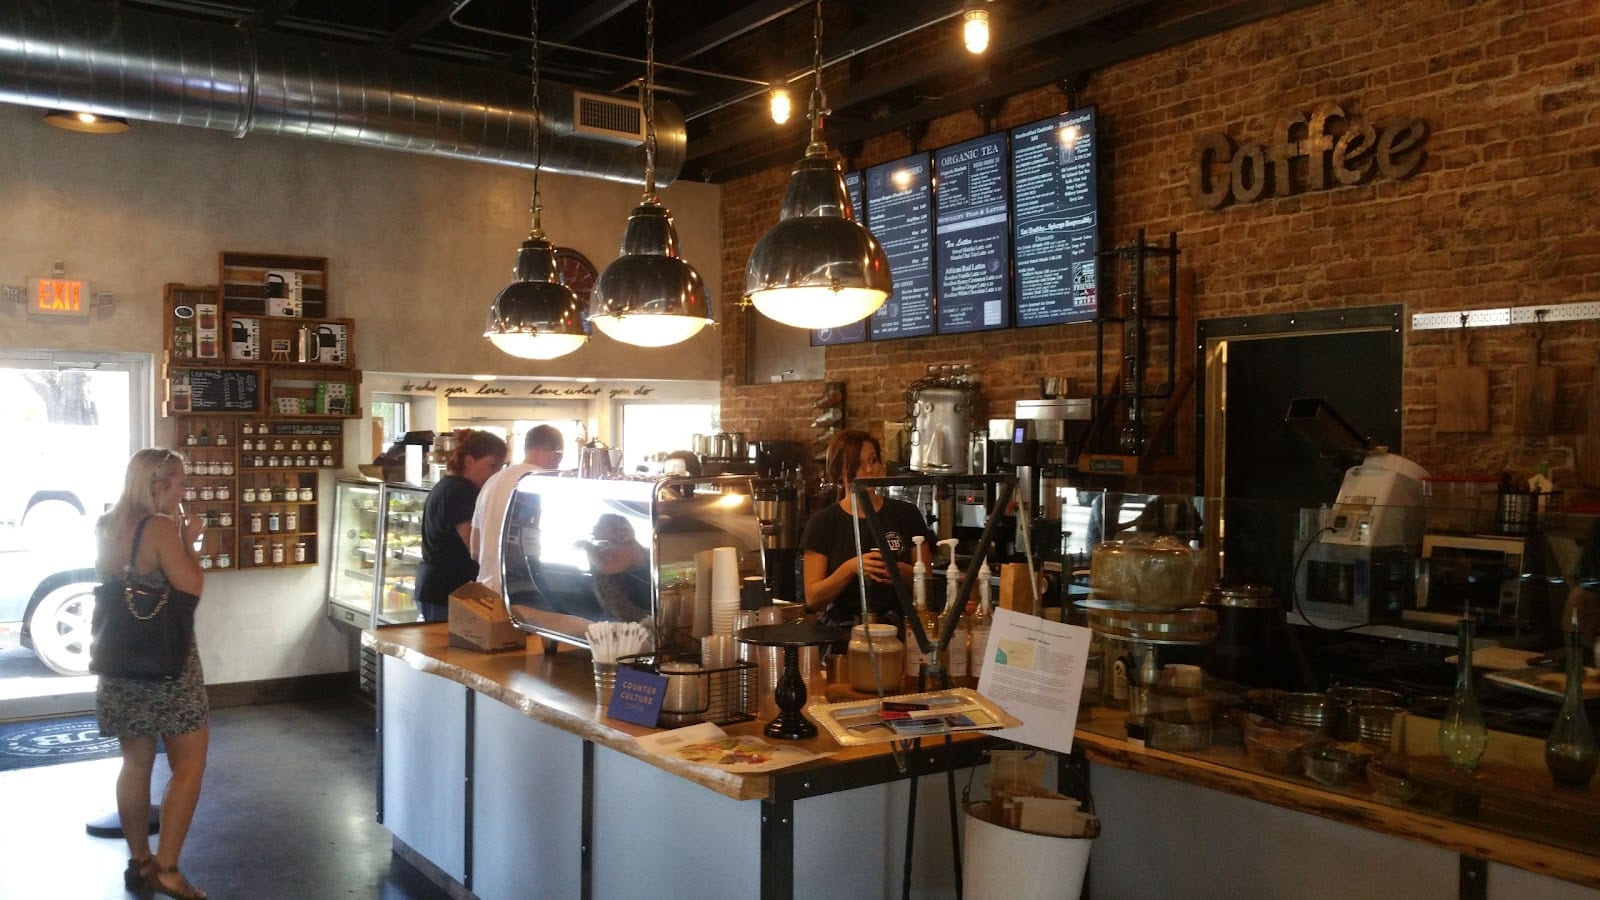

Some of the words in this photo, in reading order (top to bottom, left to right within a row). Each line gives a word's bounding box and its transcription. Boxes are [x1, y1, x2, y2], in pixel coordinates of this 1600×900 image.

[941, 149, 979, 167] ORGANIC
[981, 145, 999, 156] TEA
[1191, 102, 1425, 209] Coffee
[39, 280, 82, 311] EXIT
[444, 386, 468, 397] you
[475, 384, 509, 395] love
[528, 384, 562, 395] love
[563, 385, 601, 395] what
[609, 388, 629, 398] you
[633, 385, 653, 395] do
[622, 681, 657, 695] COUNTER
[620, 691, 654, 705] CULTURE
